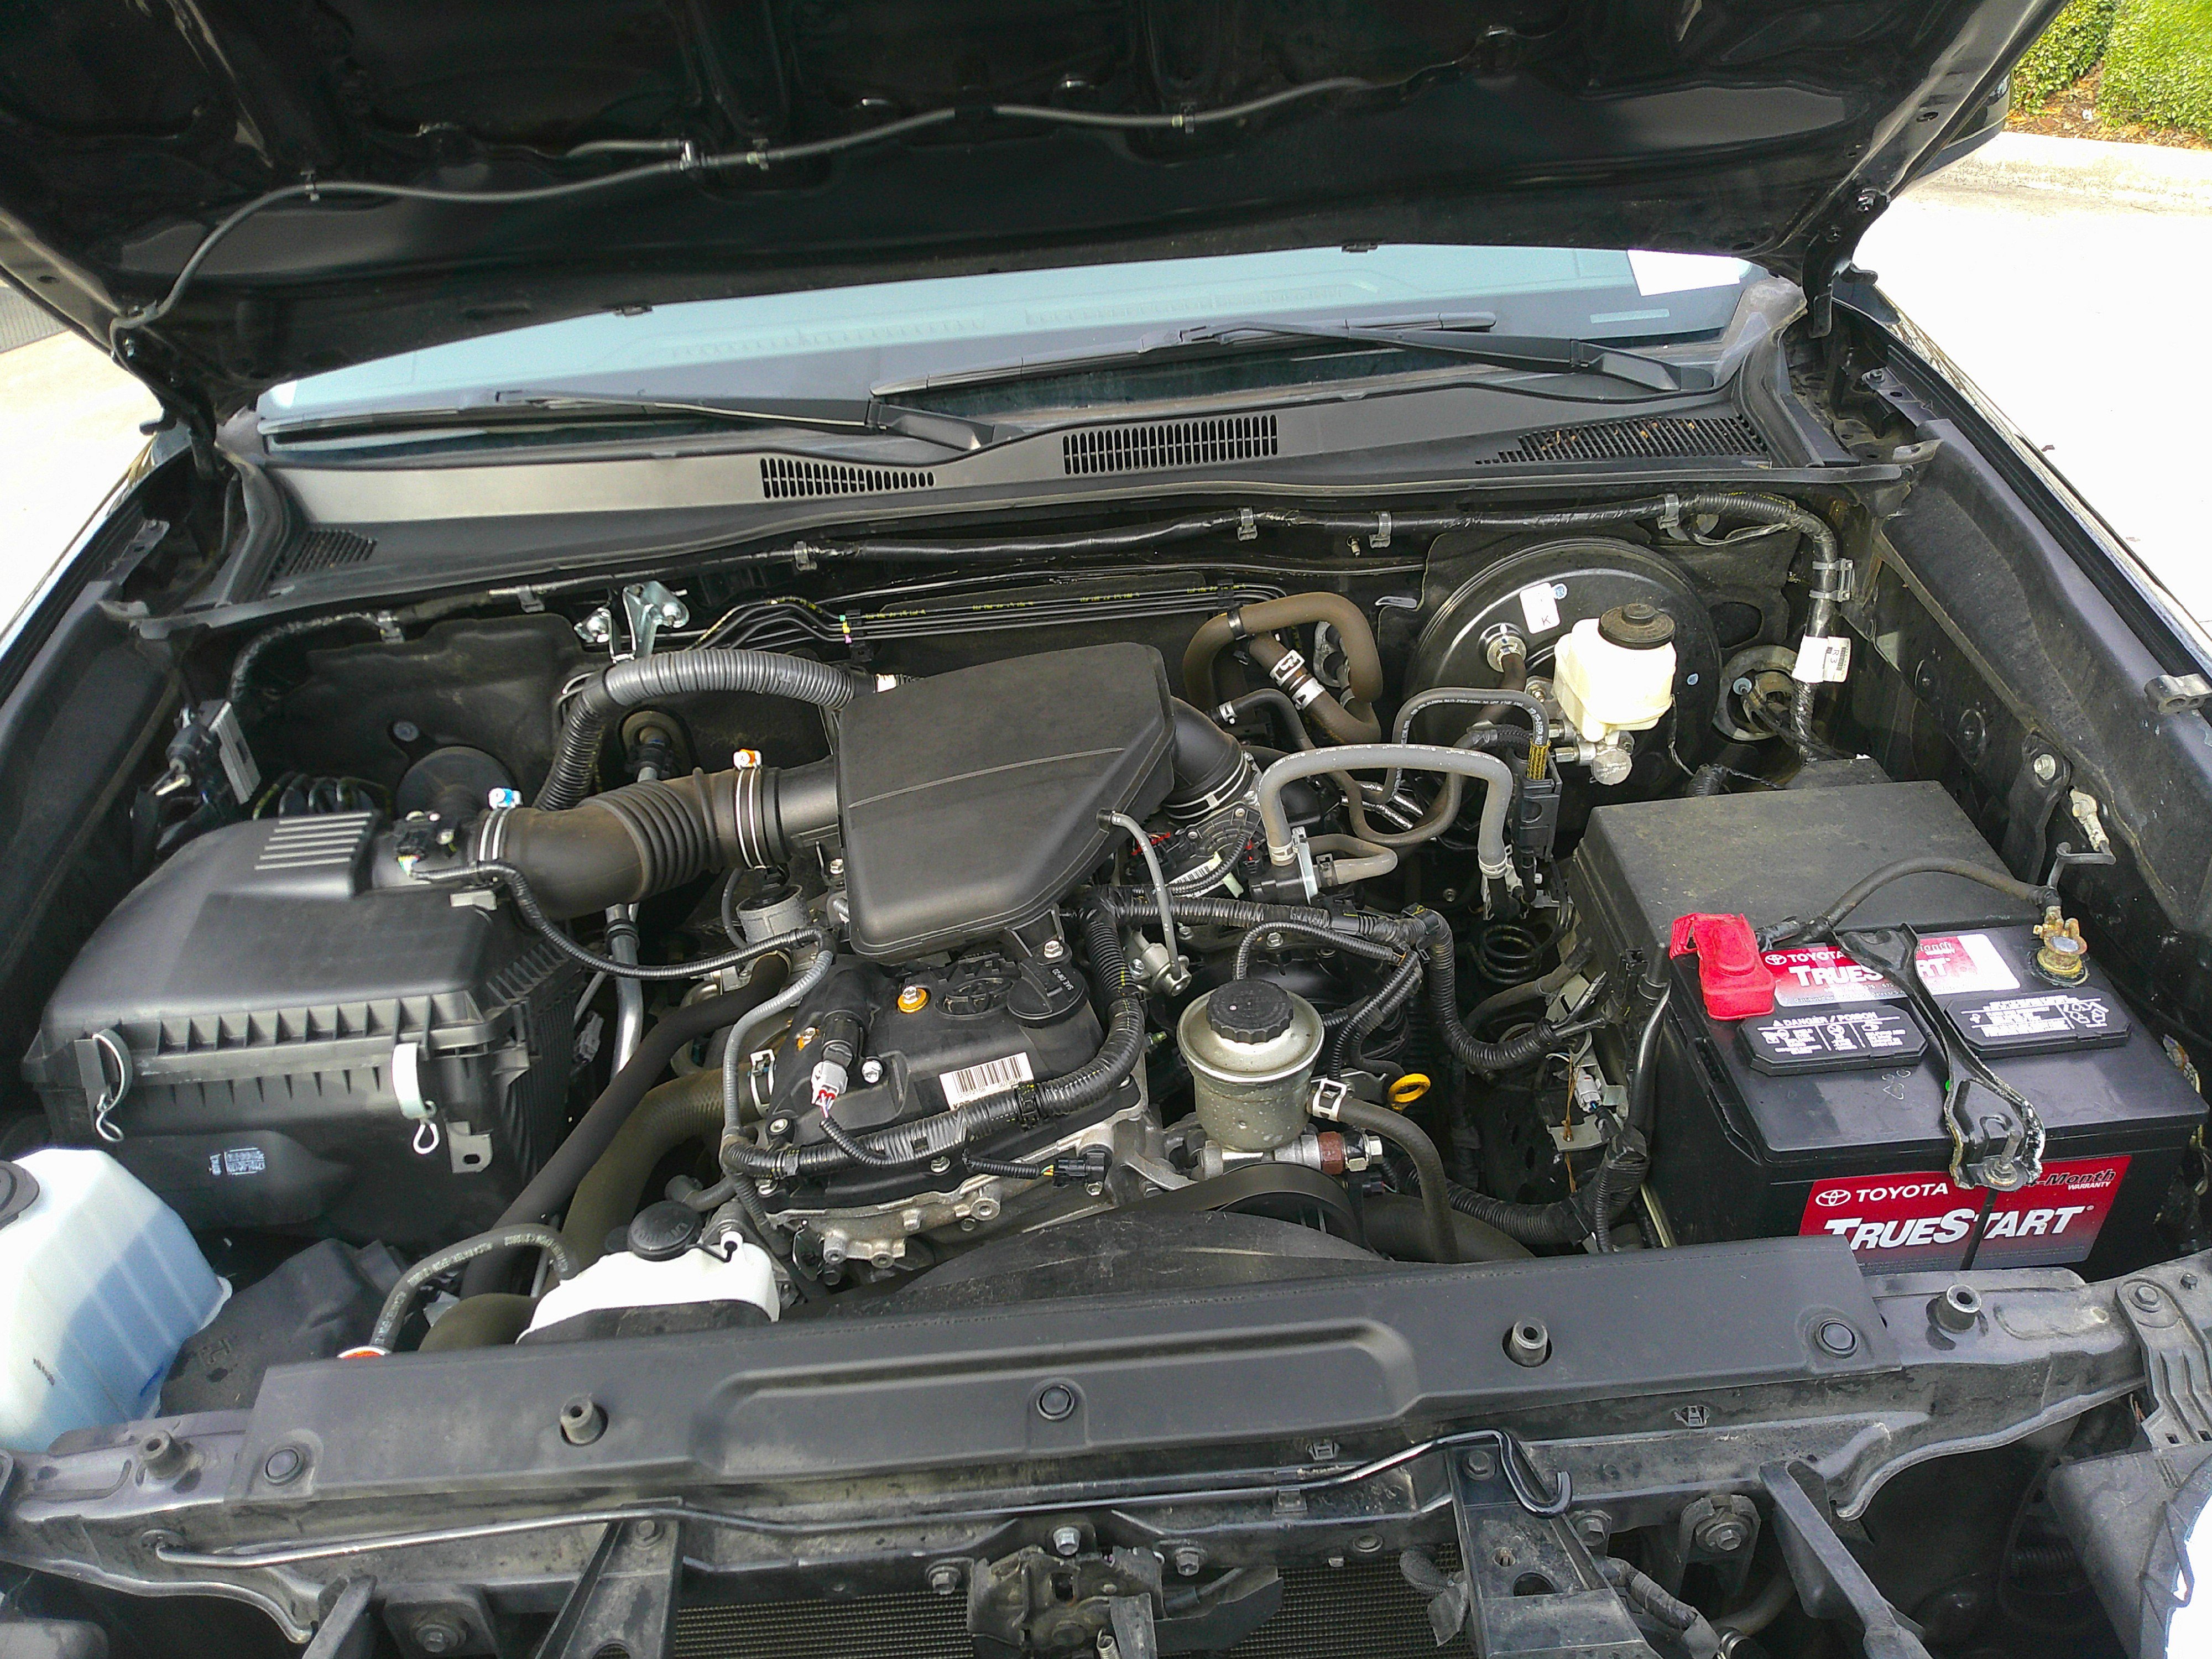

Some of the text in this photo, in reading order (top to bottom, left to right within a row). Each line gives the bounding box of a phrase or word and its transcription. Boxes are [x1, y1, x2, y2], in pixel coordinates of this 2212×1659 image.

[1541, 615, 1551, 626] K
[1787, 951, 1846, 963] TOYOTA
[1063, 980, 1074, 991] SAE
[1837, 1011, 1878, 1022] POISON
[2068, 1181, 2111, 1190] WARRANTY
[1856, 1182, 1949, 1203] TOYOTA
